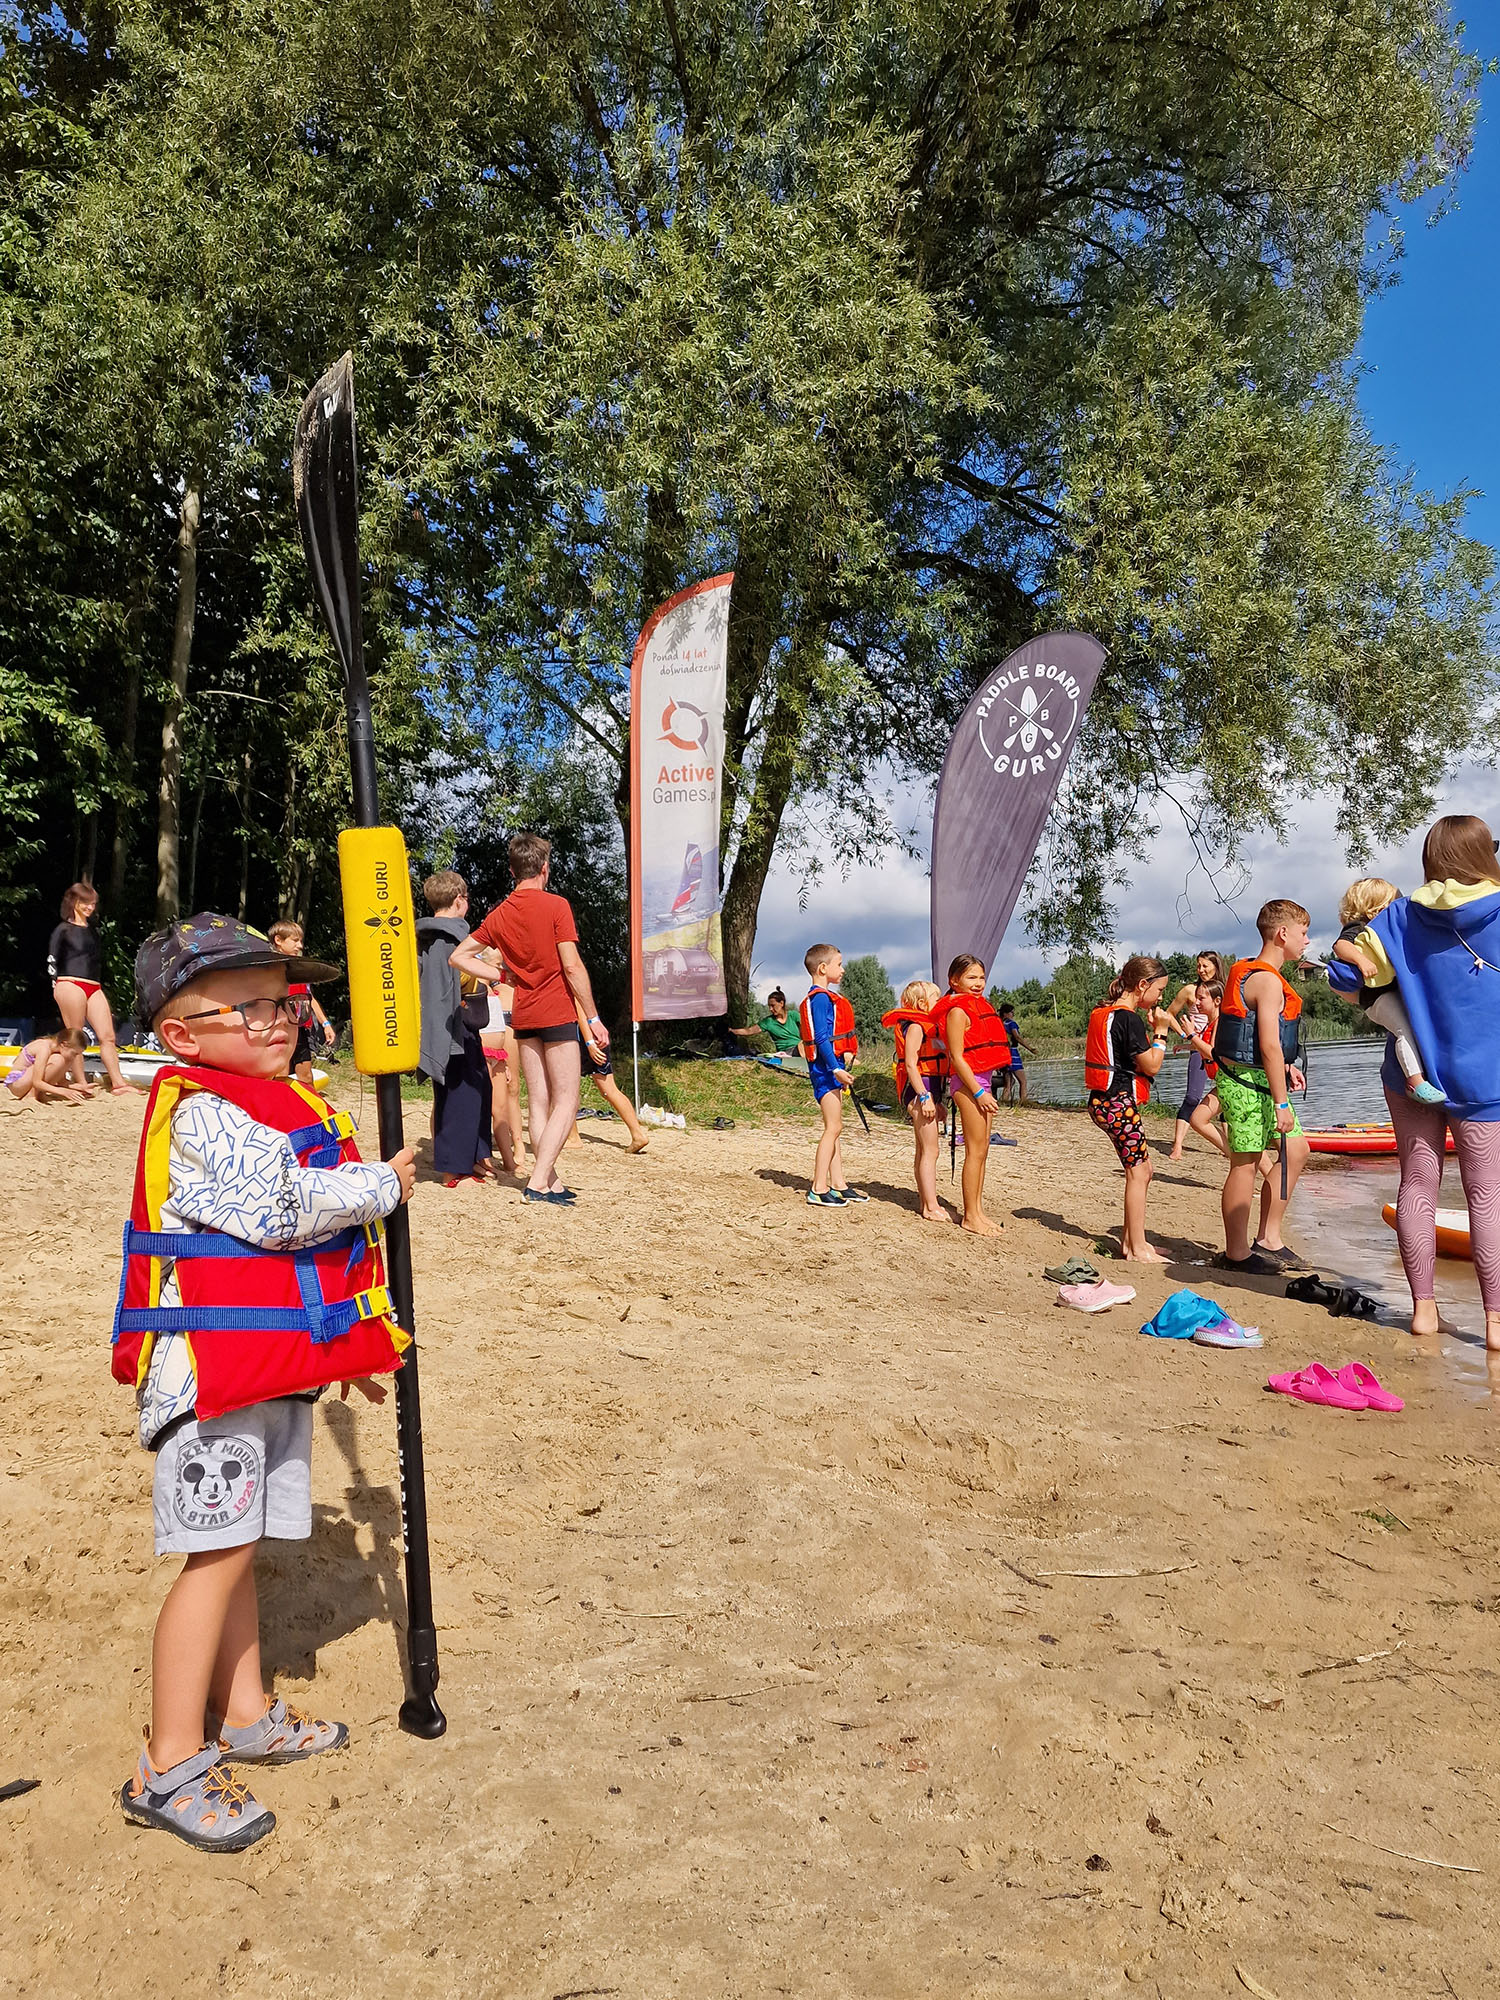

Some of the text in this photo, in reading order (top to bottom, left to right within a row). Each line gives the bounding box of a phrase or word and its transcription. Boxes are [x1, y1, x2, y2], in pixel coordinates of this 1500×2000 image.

[652, 647, 708, 662] Ponad 14 lat
[976, 663, 1081, 718] PADDLE BOARD
[1008, 709, 1050, 728] P B
[1025, 732, 1034, 744] G
[657, 763, 715, 784] Active
[993, 741, 1063, 778] GURU
[375, 861, 399, 1047] PADDLE BOARD GURU
[221, 1443, 256, 1478] MOUSE
[187, 1510, 231, 1526] STAR
[233, 1480, 256, 1513] 1928
